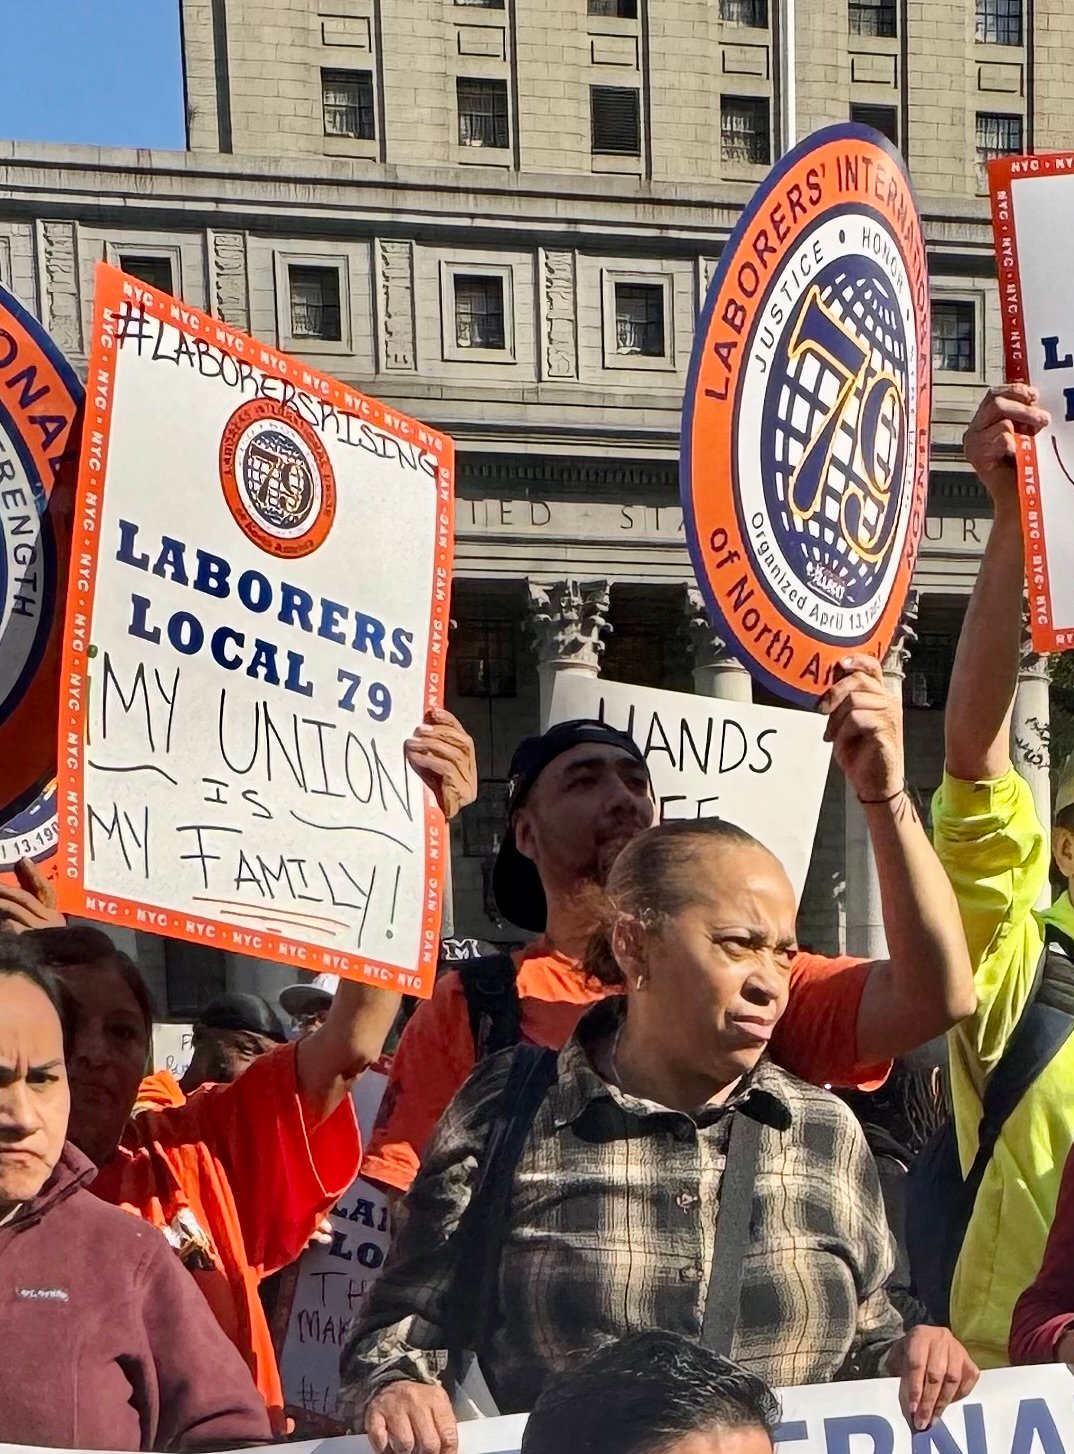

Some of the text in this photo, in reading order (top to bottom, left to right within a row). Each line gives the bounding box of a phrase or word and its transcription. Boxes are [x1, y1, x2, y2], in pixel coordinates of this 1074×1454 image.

[1011, 161, 1039, 172] NYC
[997, 190, 1008, 220] NYC
[1002, 237, 1014, 268] NYC
[705, 163, 827, 401] LABORERS'
[755, 226, 904, 373] JUSTICE HONOR
[1007, 283, 1017, 314] NYC
[123, 282, 444, 451] NYC NYC NYC NYC NYC NYC NYC NYC
[94, 368, 109, 407] NYC
[788, 284, 906, 563] 79
[90, 432, 103, 470] NYC
[1024, 466, 1035, 494] NYC
[84, 492, 98, 531] NYC
[1028, 511, 1040, 538] NYC
[0, 450, 38, 618] RENGTH
[79, 553, 92, 592] NYC
[751, 511, 807, 611] Organized
[1032, 555, 1044, 583] NYC
[116, 519, 414, 668] LABORERS
[710, 527, 796, 670] of North
[1035, 595, 1047, 624] NYC
[73, 613, 87, 653] NYC
[128, 593, 392, 722] LOCAL 79
[69, 673, 82, 711] NYC
[66, 732, 78, 770] NYC
[103, 651, 414, 822] MY UNION
[66, 792, 78, 832] NYC
[202, 778, 272, 819] IS
[66, 842, 78, 879] NYC
[87, 802, 401, 948] MY FAMILY!
[86, 897, 422, 989] NYC NYC NYC NYC NYC NYC NYC NYC
